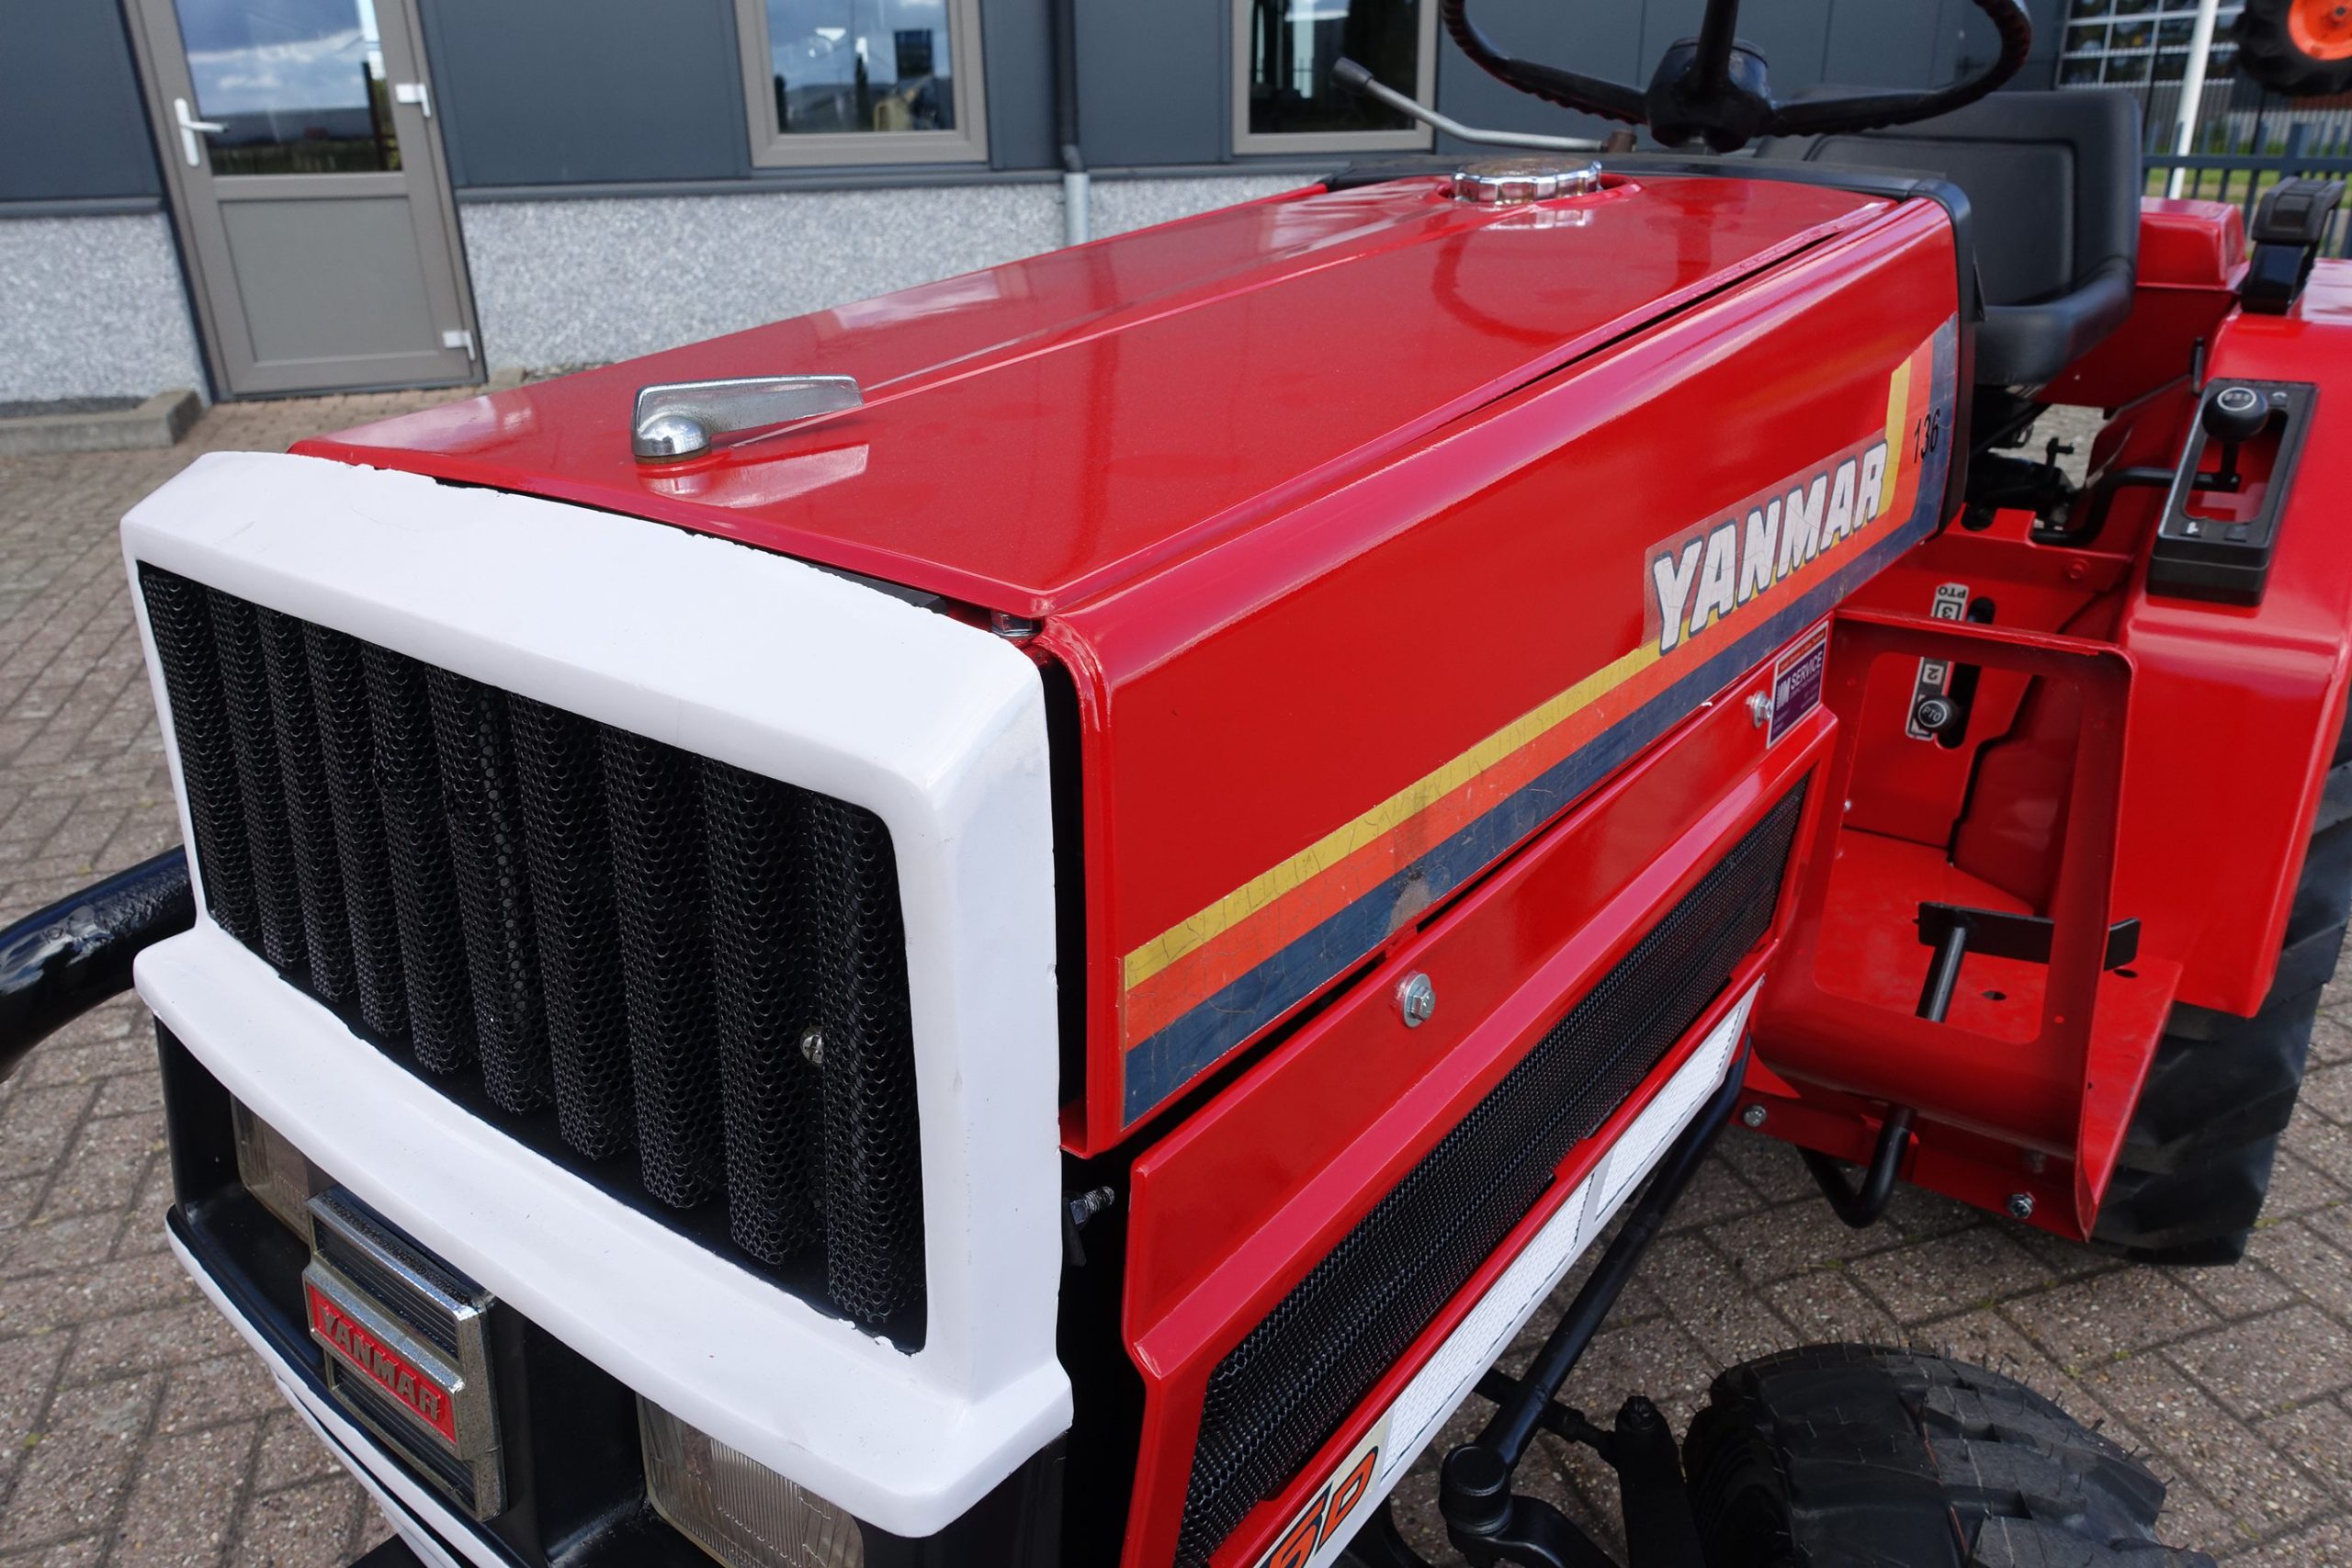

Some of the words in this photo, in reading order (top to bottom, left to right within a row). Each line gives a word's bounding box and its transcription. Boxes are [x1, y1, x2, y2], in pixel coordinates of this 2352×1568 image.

[1914, 408, 1940, 464] 136
[1653, 438, 1888, 656] YANMAR
[1938, 586, 1967, 599] PTO
[1942, 606, 1953, 619] 3
[1791, 650, 1823, 691] SERVICE
[1928, 668, 1939, 681] 2
[1922, 706, 1941, 722] PTO
[322, 1305, 442, 1422] YANMAR
